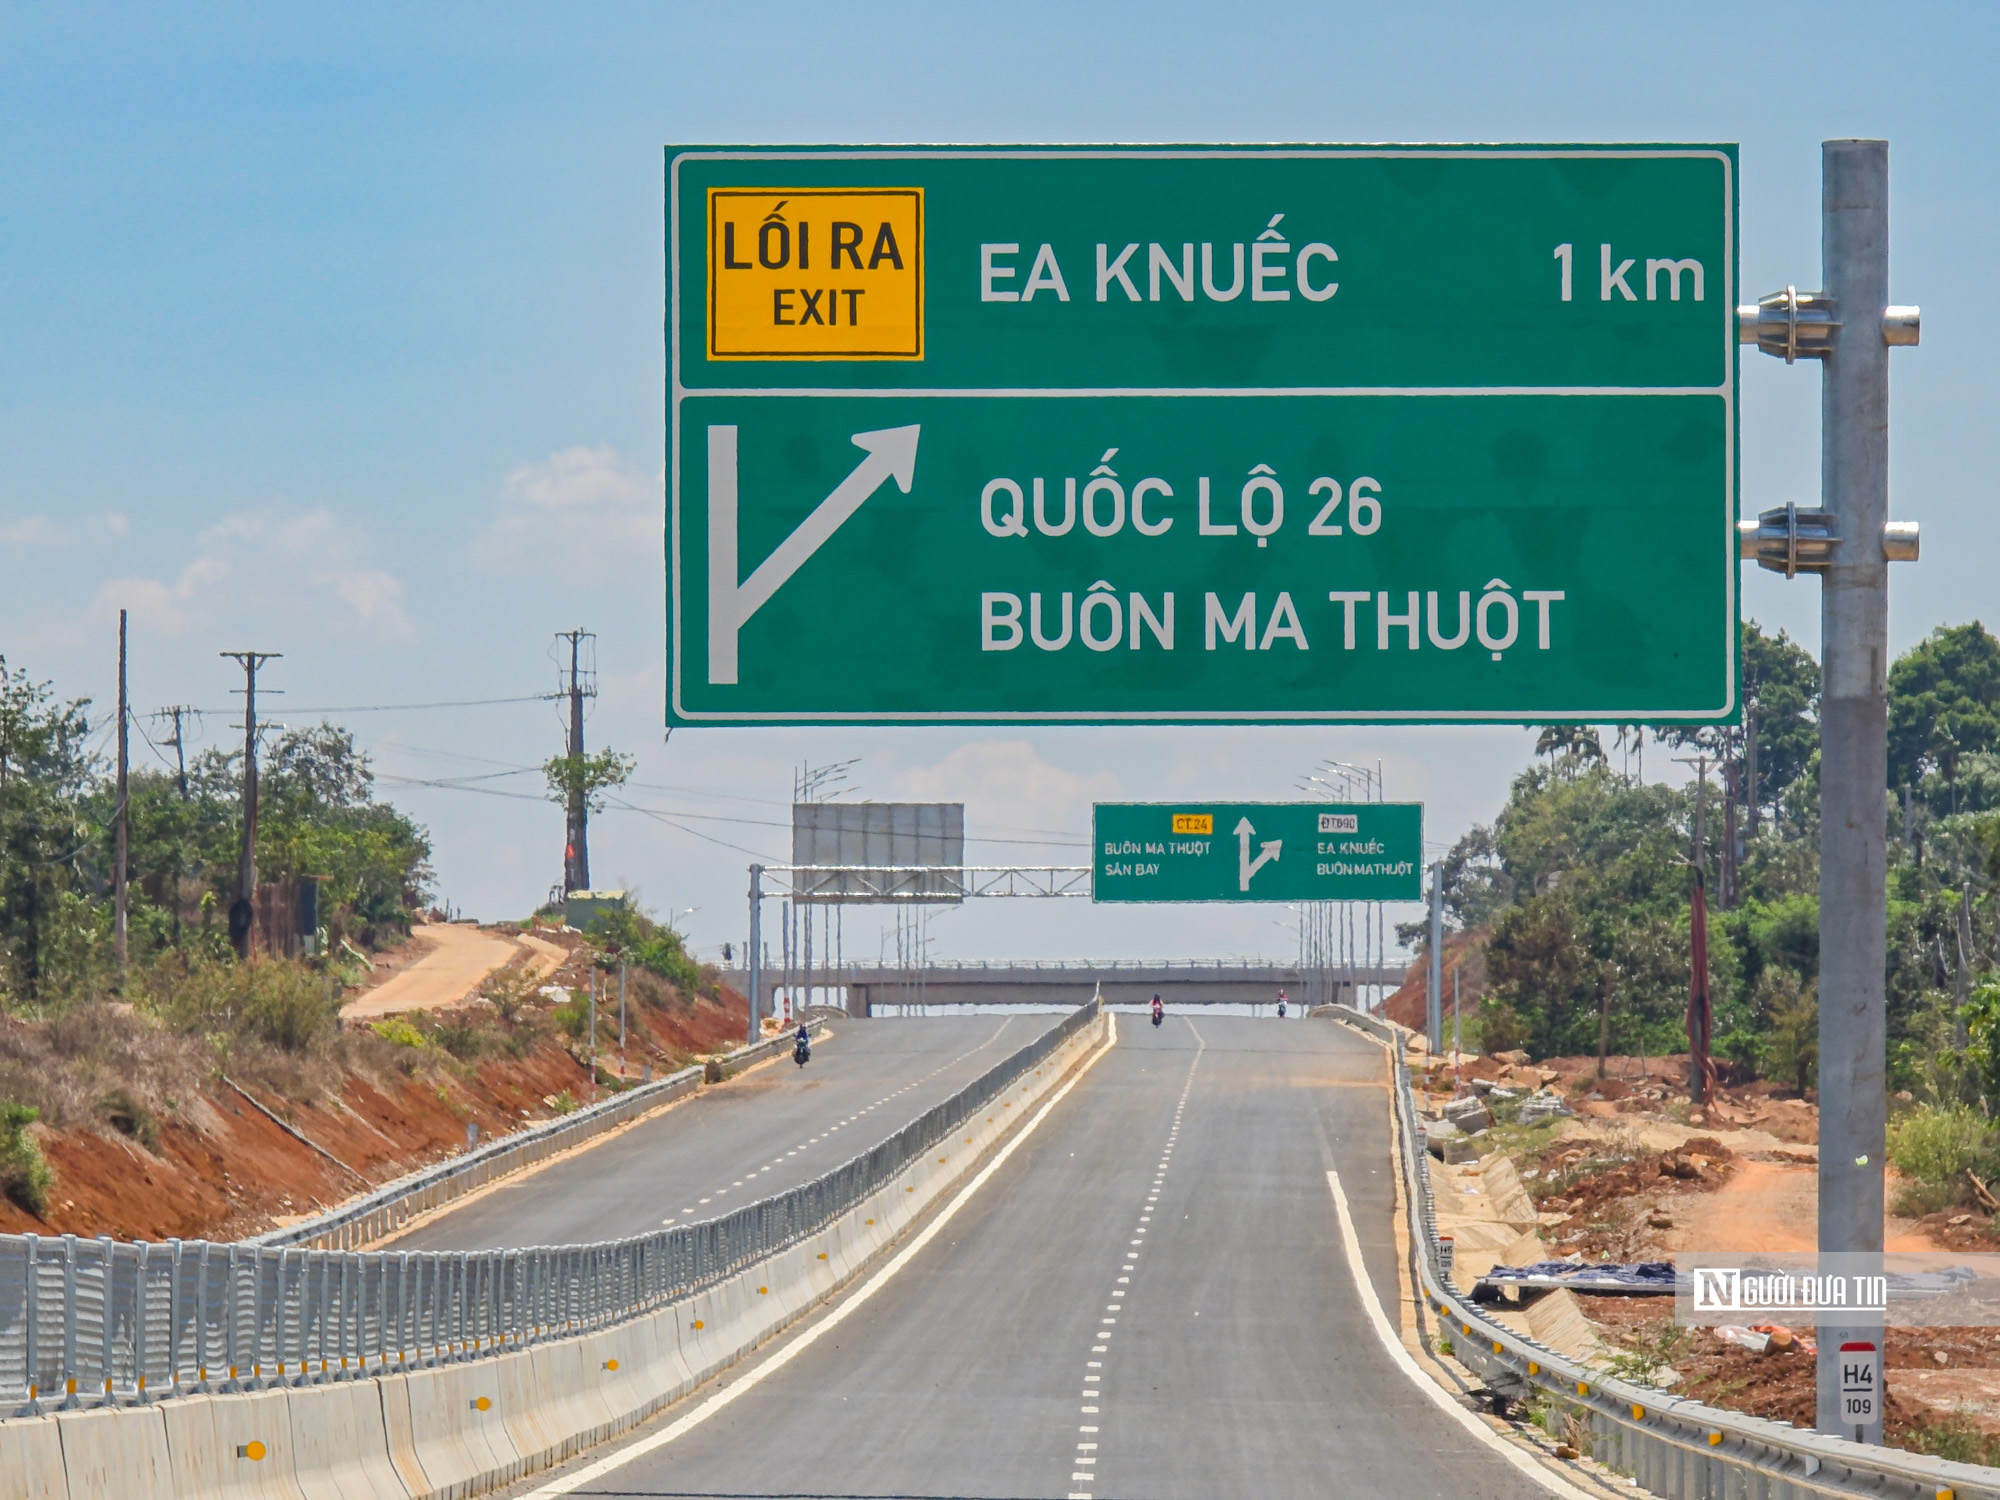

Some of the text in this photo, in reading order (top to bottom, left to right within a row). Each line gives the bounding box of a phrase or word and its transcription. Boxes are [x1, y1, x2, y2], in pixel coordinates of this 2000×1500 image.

[724, 200, 904, 270] LỐI RA
[980, 213, 1339, 303] EA KNUẾC
[1553, 243, 1705, 302] 1 km
[773, 288, 866, 327] EXIT
[980, 447, 1382, 548] QUỐC LỘ 26
[981, 577, 1566, 662] BUÔN MA THUỘT
[1176, 818, 1208, 831] CT.24
[1104, 840, 1211, 857] BUÔN MA THUỘT
[1317, 837, 1385, 854] EA KNUẾC
[1105, 862, 1160, 876] SÂN BAY
[1317, 861, 1414, 877] BUÔN MA THUỘT
[1843, 1364, 1873, 1384] H4
[1846, 1398, 1871, 1415] 109
